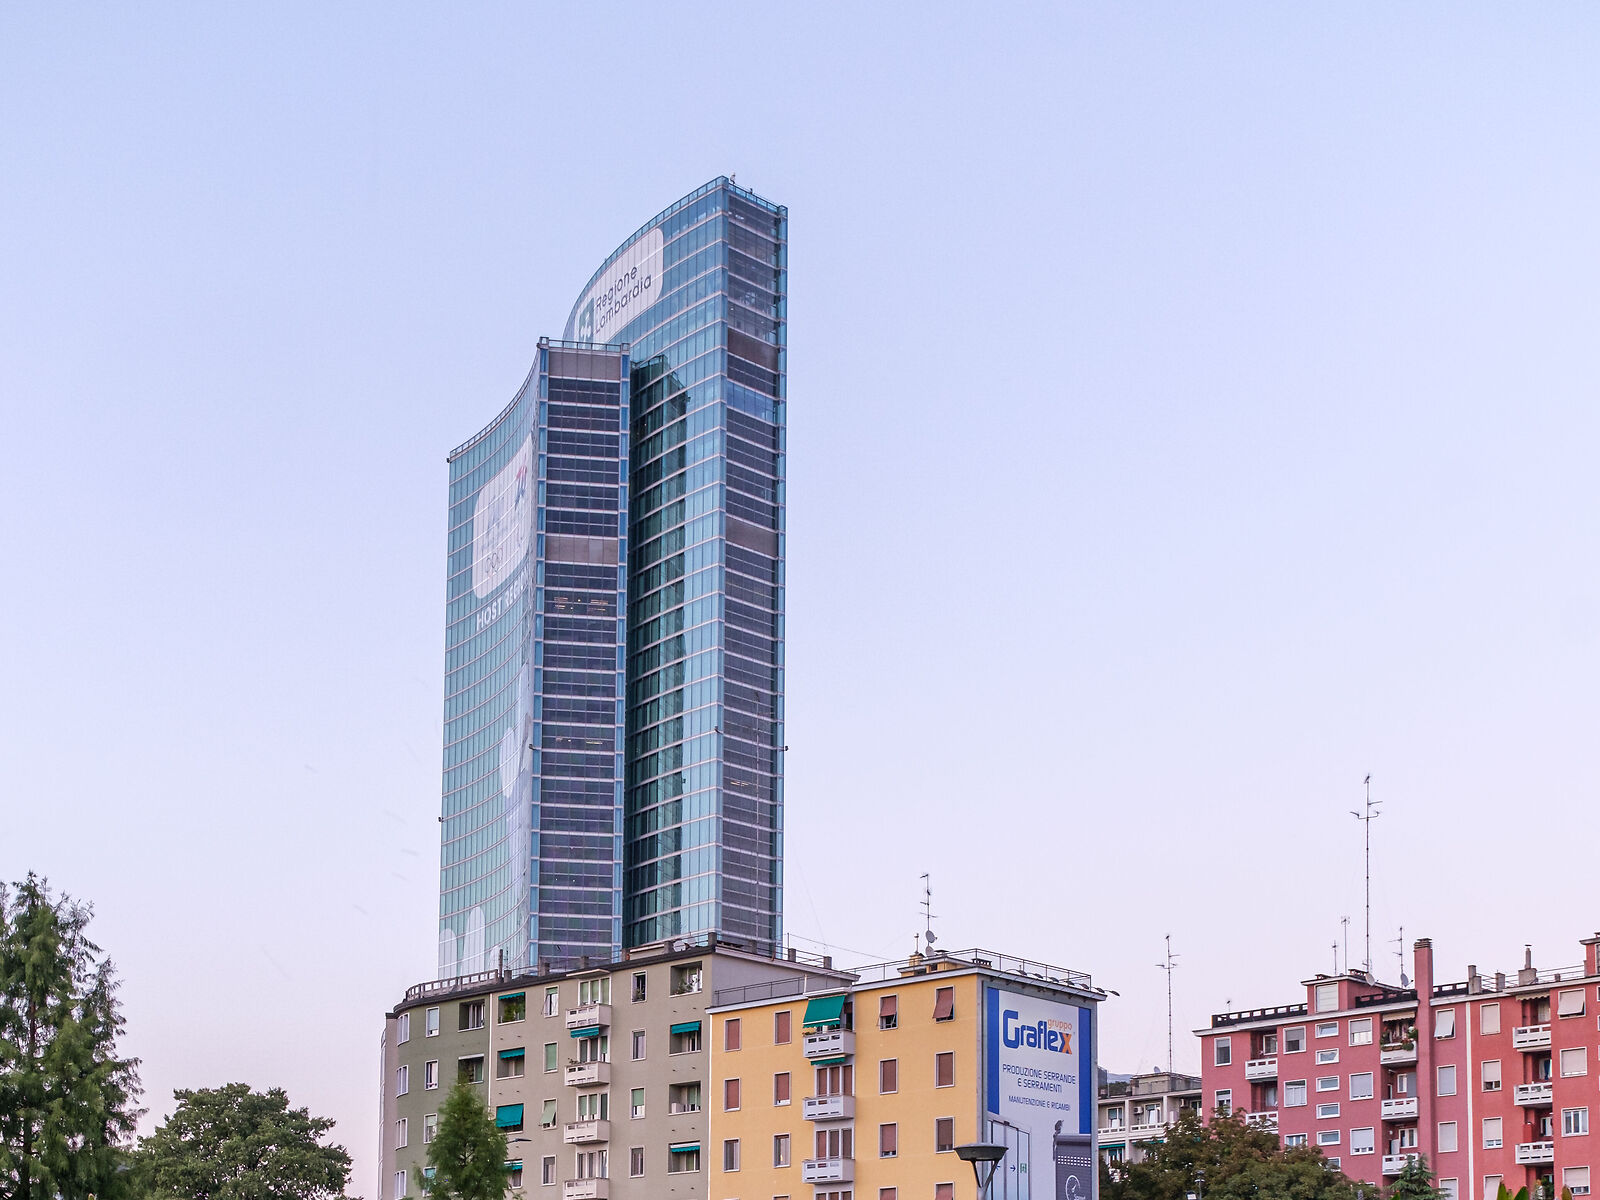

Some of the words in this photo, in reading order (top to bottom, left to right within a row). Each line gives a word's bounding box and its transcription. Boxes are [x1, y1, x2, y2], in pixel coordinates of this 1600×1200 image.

[596, 266, 638, 311] Regione
[595, 274, 652, 334] Lombardia
[476, 597, 502, 632] HOST
[1002, 1009, 1073, 1055] Graflex
[1047, 1019, 1073, 1031] gruppo
[1002, 1063, 1042, 1079] PRODUZIONE
[1043, 1070, 1076, 1085] SERRANDE
[1017, 1077, 1022, 1087] E
[1023, 1078, 1063, 1093] SERRAMENTI
[1008, 1095, 1046, 1108] MANUTENZIONE
[1051, 1100, 1071, 1111] RICAMBI
